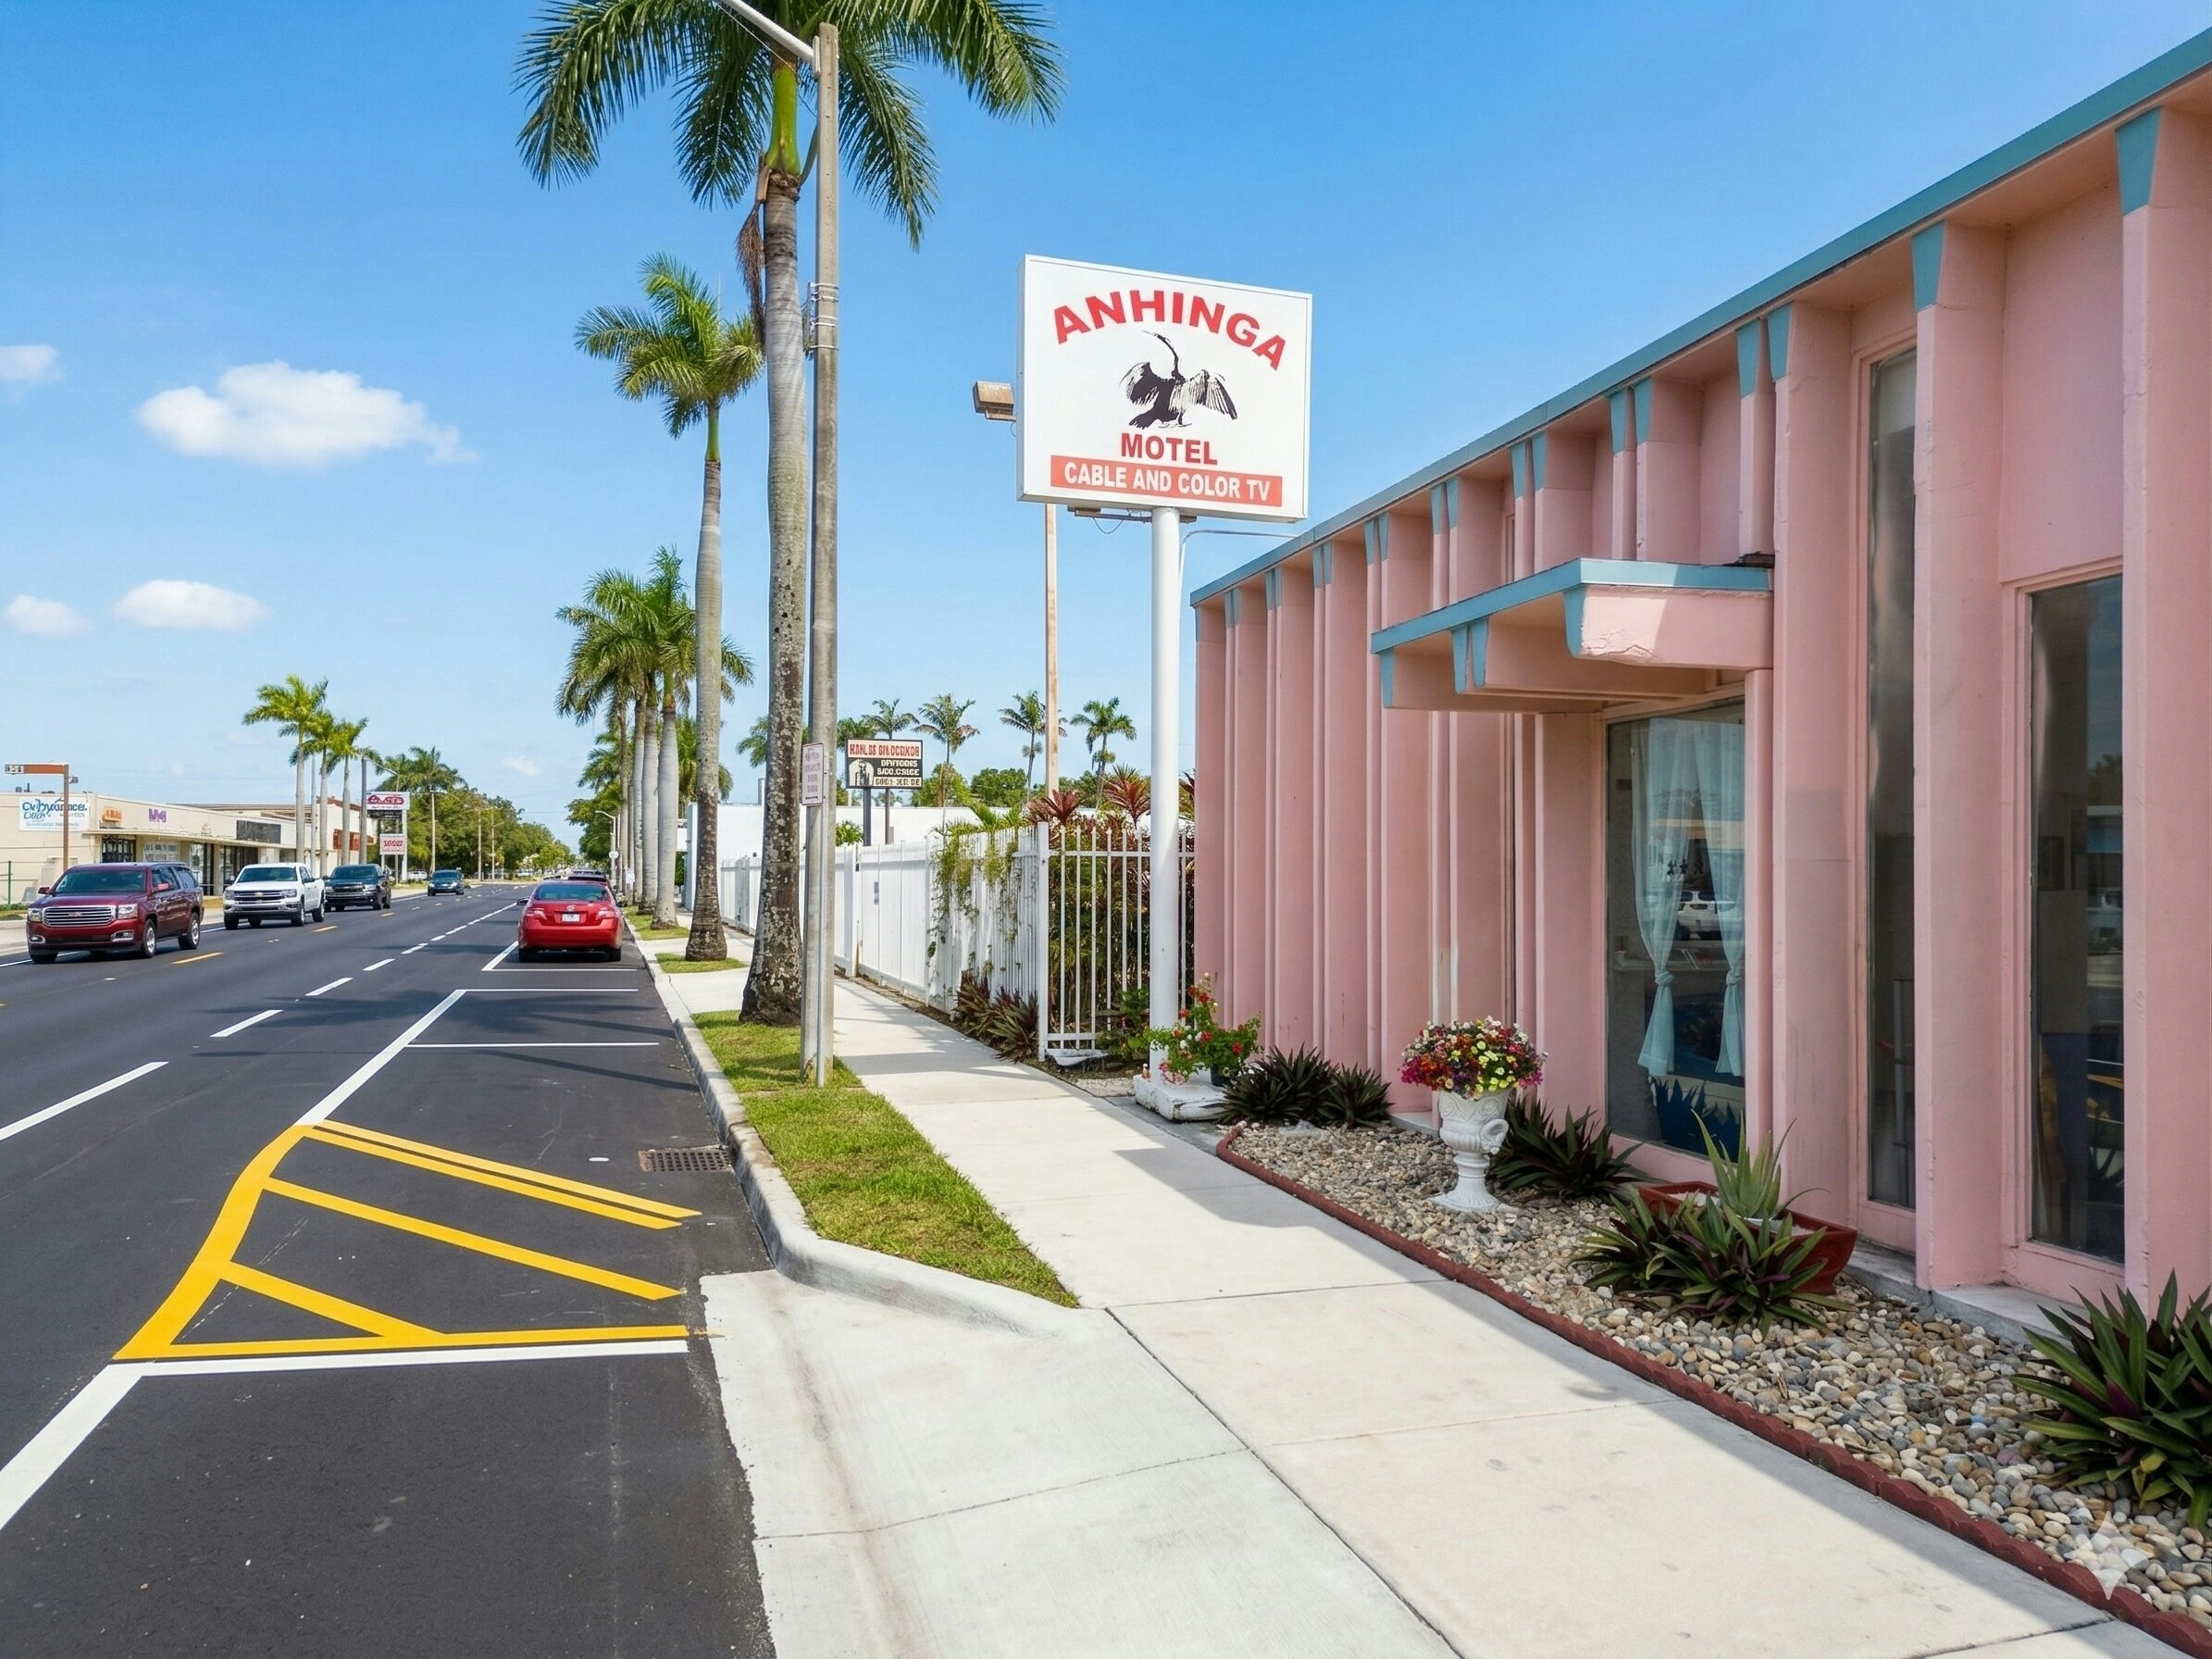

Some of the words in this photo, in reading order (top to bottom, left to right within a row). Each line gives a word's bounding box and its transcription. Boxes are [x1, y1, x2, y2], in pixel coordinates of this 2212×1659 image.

[1054, 290, 1286, 370] ANHINGA
[1121, 432, 1218, 465] MOTEL
[1063, 461, 1127, 489] CABLE
[1132, 468, 1173, 493] AND
[1177, 472, 1240, 499] COLOR
[1247, 479, 1271, 502] TV
